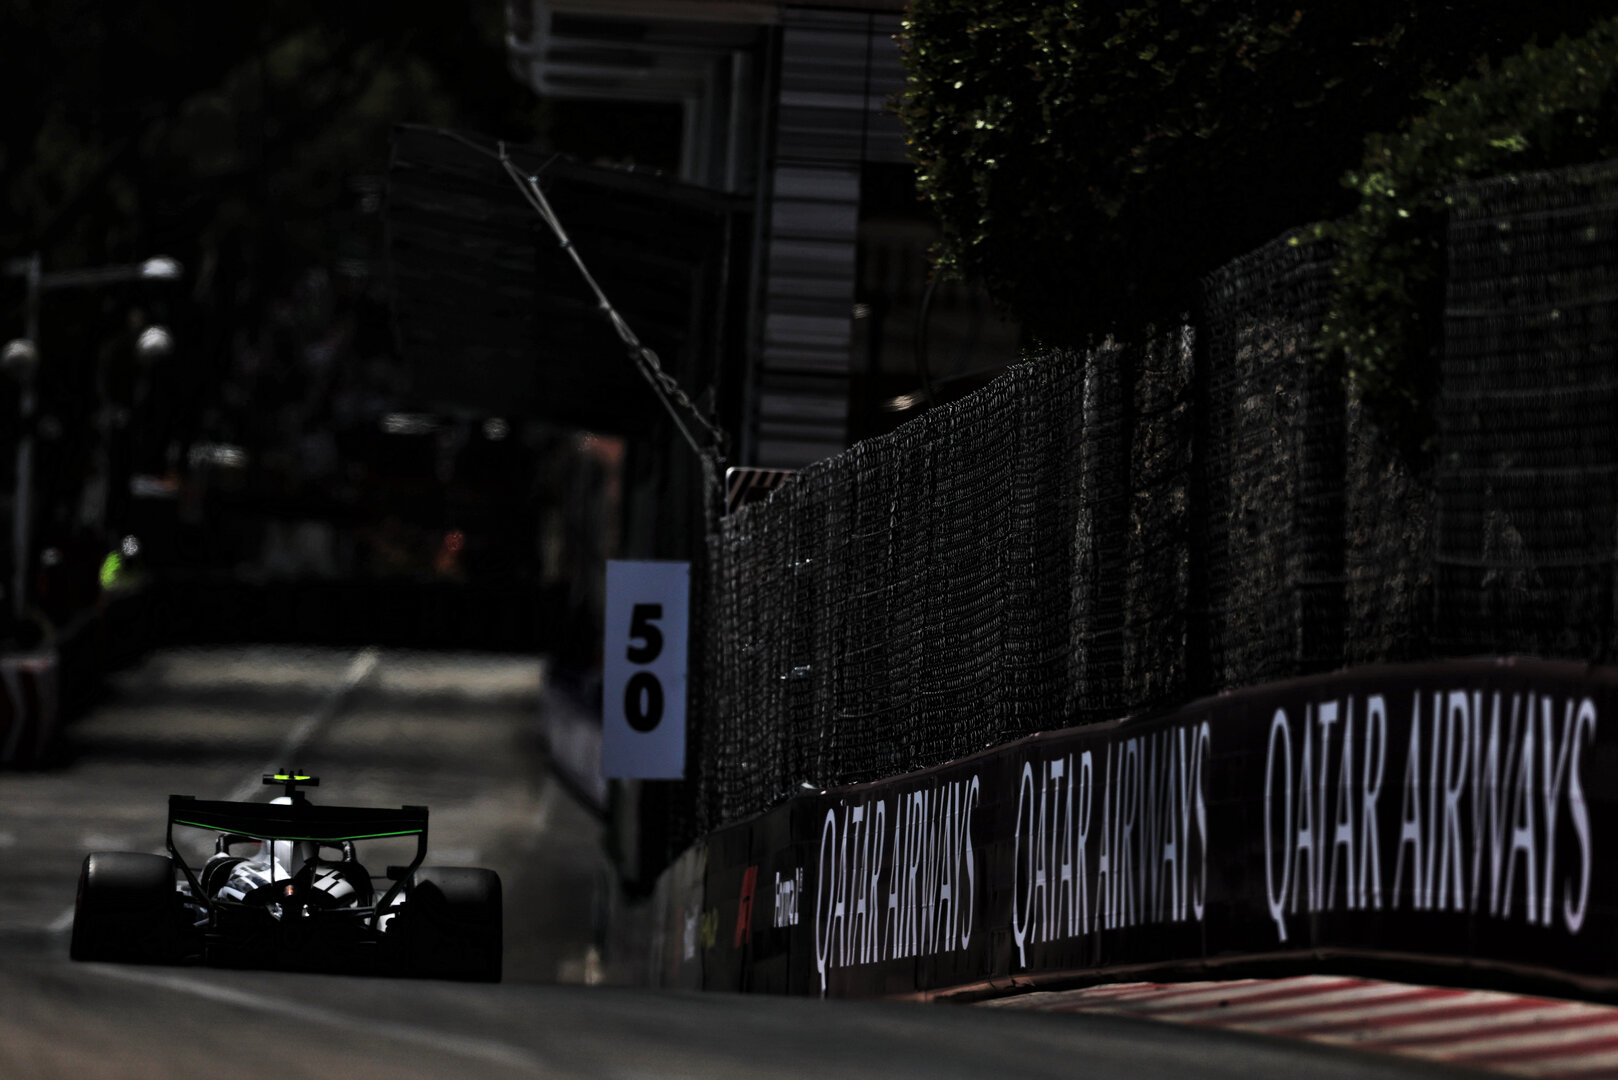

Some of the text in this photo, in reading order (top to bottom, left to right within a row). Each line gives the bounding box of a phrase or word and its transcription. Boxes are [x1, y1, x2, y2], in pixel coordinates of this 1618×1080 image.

[816, 799, 886, 997] QATAR
[883, 774, 980, 961] AIRWAYS
[1013, 720, 1211, 968] QATAR AIRWAYS
[1264, 689, 1597, 943] QATAR AIRWAYS
